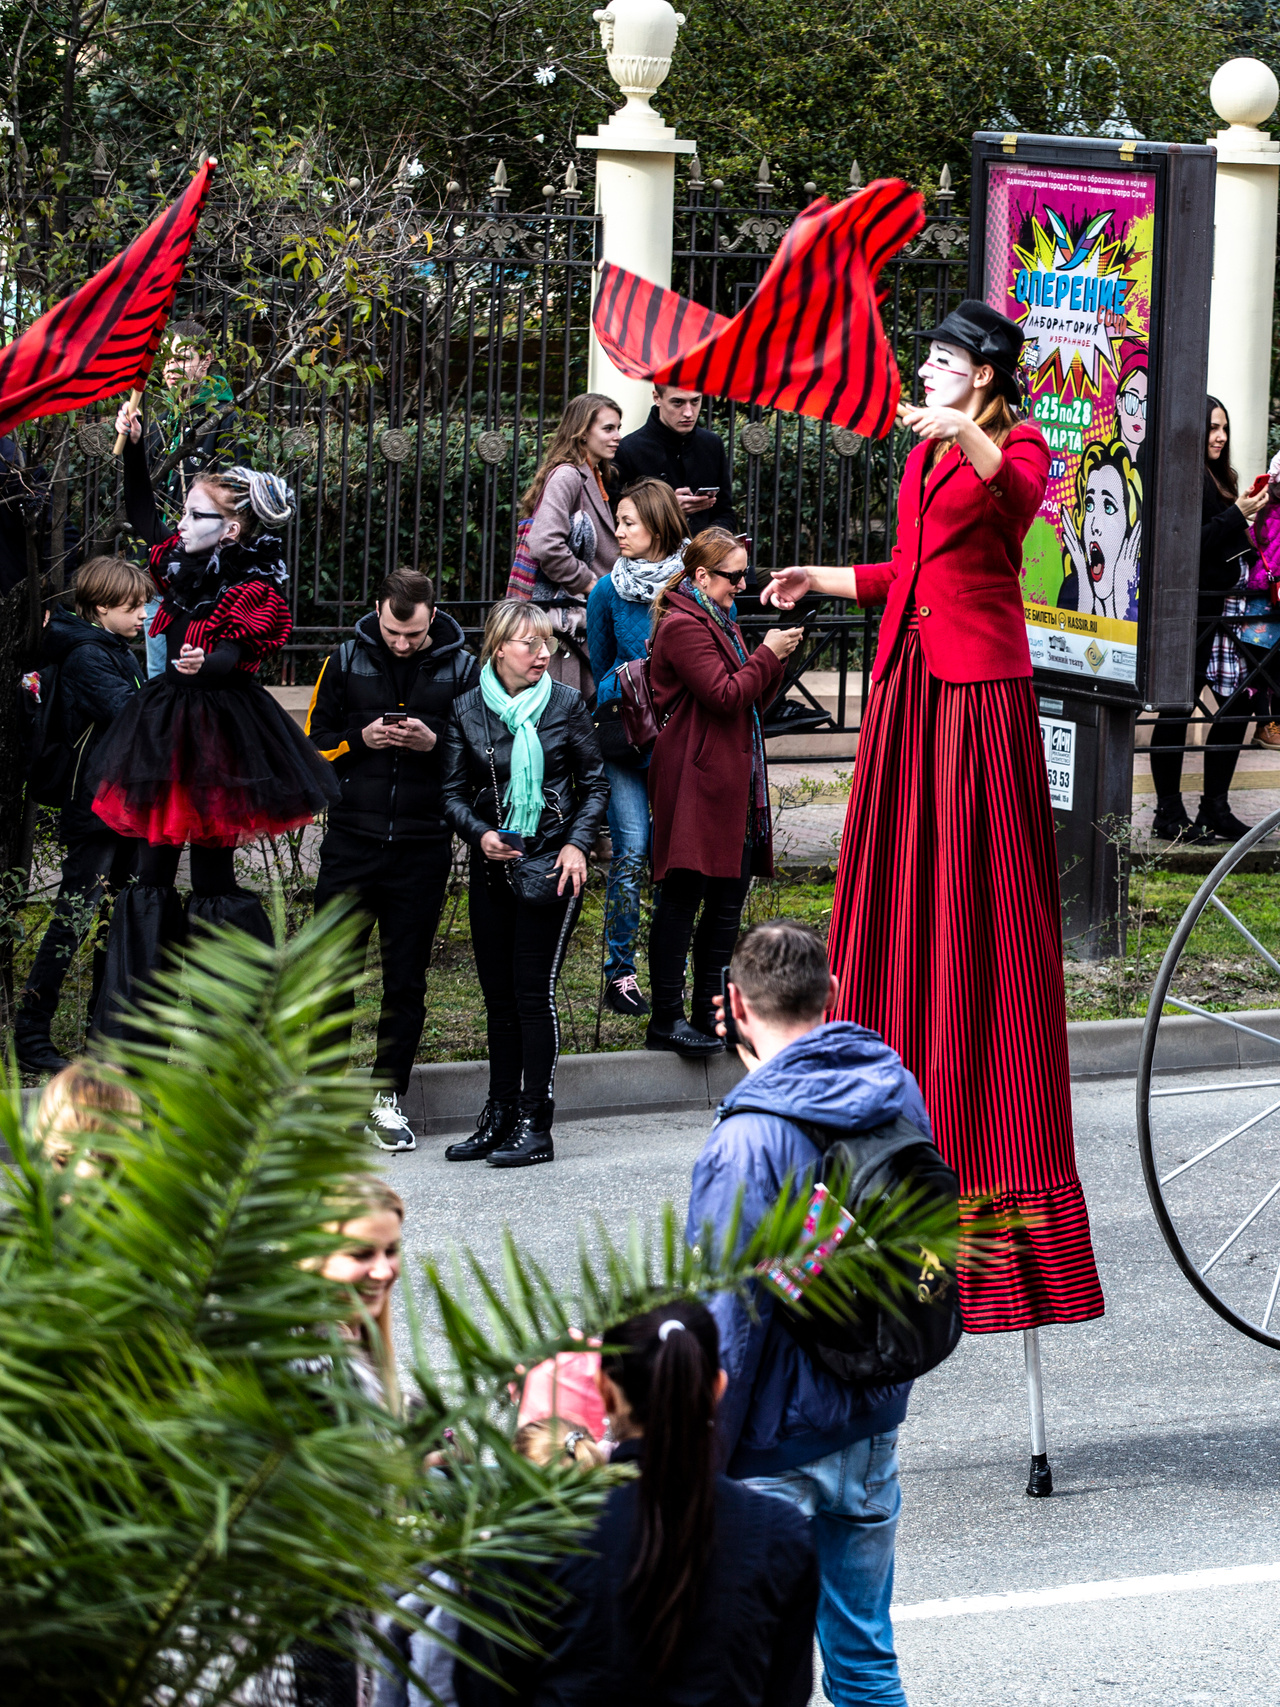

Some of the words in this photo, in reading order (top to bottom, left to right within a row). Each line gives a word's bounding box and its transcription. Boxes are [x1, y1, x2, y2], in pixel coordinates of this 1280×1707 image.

[1006, 177, 1048, 189] администрации
[1049, 182, 1068, 191] города
[1068, 183, 1083, 192] Сочи
[1088, 185, 1111, 195] Зимнего
[1112, 189, 1130, 199] театра
[1131, 189, 1146, 199] Сочи
[1018, 168, 1047, 178] поддержке
[1048, 170, 1080, 180] Управления
[1081, 174, 1087, 182] по
[1088, 174, 1125, 185] образованию
[1130, 180, 1147, 189] науке
[1015, 268, 1127, 315] ОПЕРЕНИЕ
[1028, 315, 1099, 336] ЛАБОРАТОРИЯ
[1097, 305, 1127, 337] СОЧИ
[1049, 335, 1091, 348] ИЗБРАННОЕ
[1041, 426, 1082, 452] МАРТА
[1032, 609, 1057, 626] БИЛЕТЫ
[1067, 616, 1098, 633] KASSIR.RU
[1069, 657, 1084, 670] театр
[1060, 770, 1070, 788] 53
